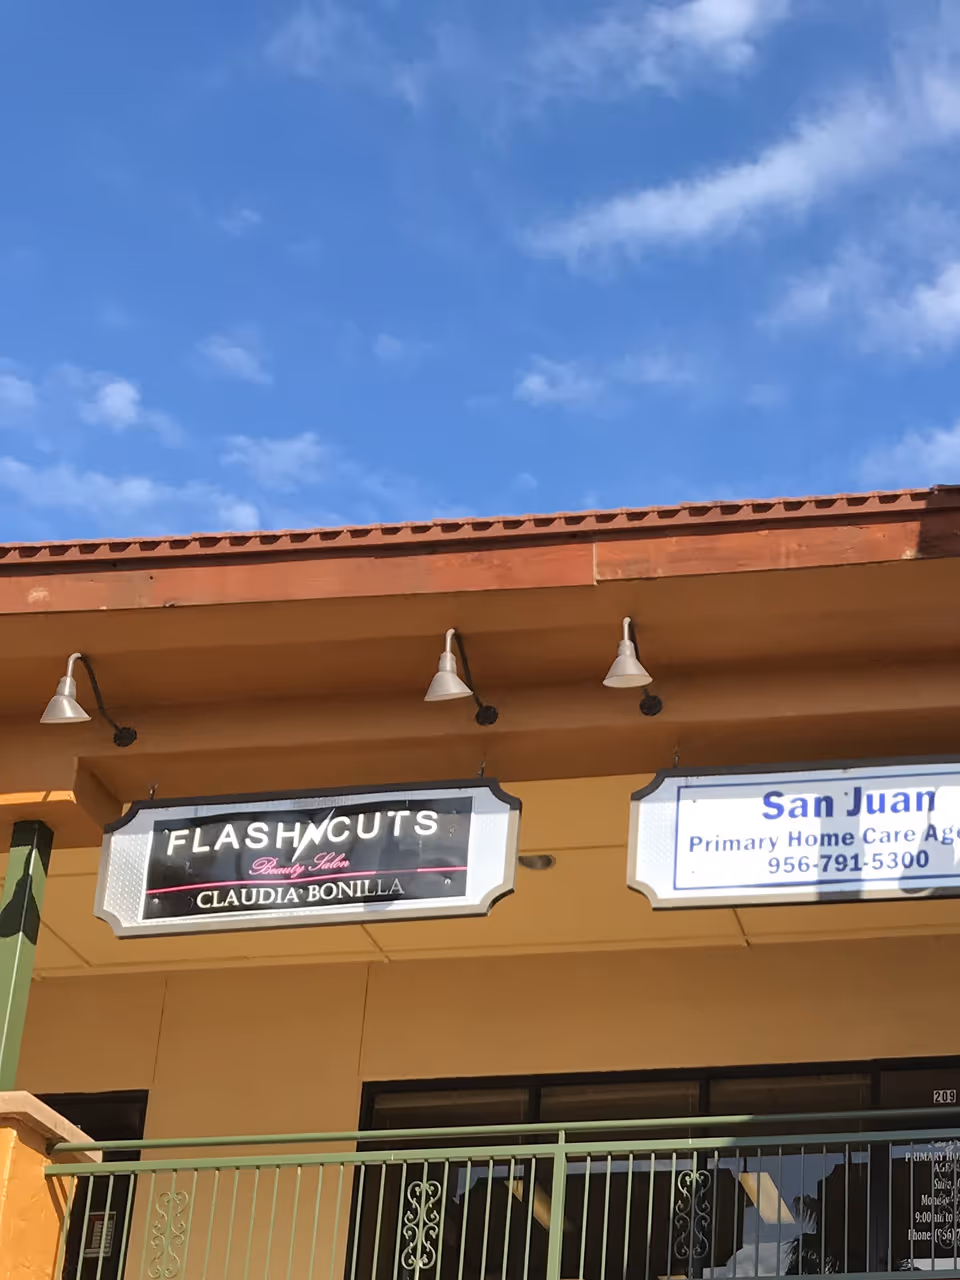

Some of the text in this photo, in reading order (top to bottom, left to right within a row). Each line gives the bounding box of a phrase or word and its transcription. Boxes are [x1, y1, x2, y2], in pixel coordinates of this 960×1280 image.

[761, 787, 937, 820] San Juan
[689, 832, 779, 854] Primary
[788, 828, 855, 848] Home
[862, 826, 917, 844] Care
[249, 851, 350, 879] Beauty Salon
[768, 849, 931, 875] 956-791-5300
[196, 878, 405, 909] CLAUDIA BONILLA
[934, 1090, 957, 1103] 209
[915, 1211, 932, 1223] 9:00
[945, 1211, 953, 1223] to
